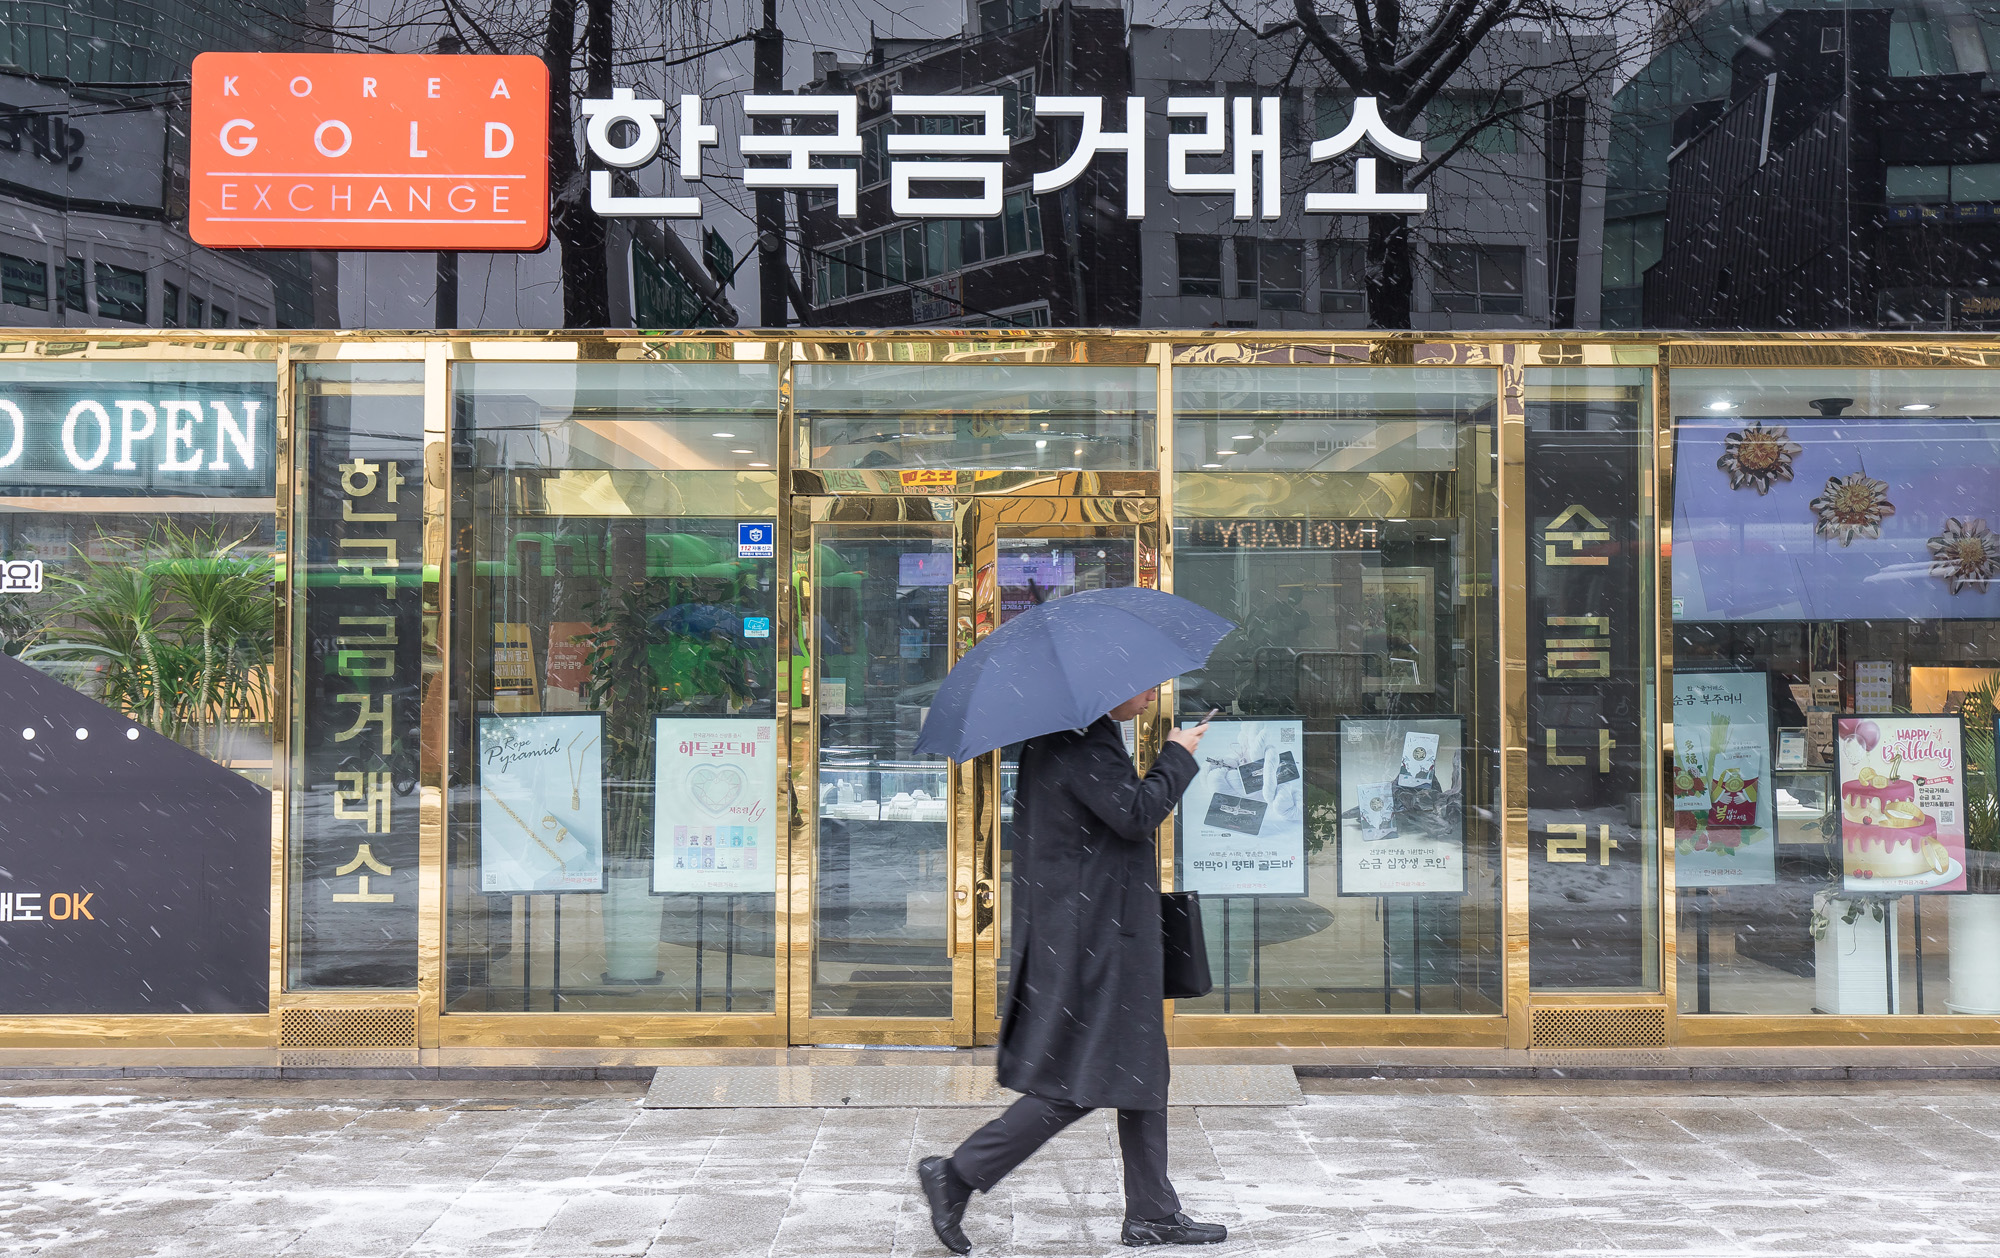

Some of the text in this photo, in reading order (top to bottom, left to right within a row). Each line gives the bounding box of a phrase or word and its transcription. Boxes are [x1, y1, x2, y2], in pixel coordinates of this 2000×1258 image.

[223, 74, 512, 100] KOREA
[218, 118, 515, 159] GOLD
[582, 88, 1428, 220] 한국금거래소
[221, 183, 510, 213] EXCHANGE
[61, 399, 262, 471] OPEN
[332, 458, 405, 903] 한국금거래소
[1545, 504, 1618, 866] 순금나라
[1700, 693, 1743, 706] 복주머니
[503, 735, 531, 751] Rope
[1897, 729, 1930, 741] HAPPY
[484, 738, 561, 774] Pyramid
[679, 740, 757, 758] 하트골드바
[1716, 805, 1728, 822] 복
[1192, 859, 1294, 873] 액막이 명태 골드바
[1358, 857, 1447, 870] 순금 십장생 코인
[49, 892, 95, 920] OK
